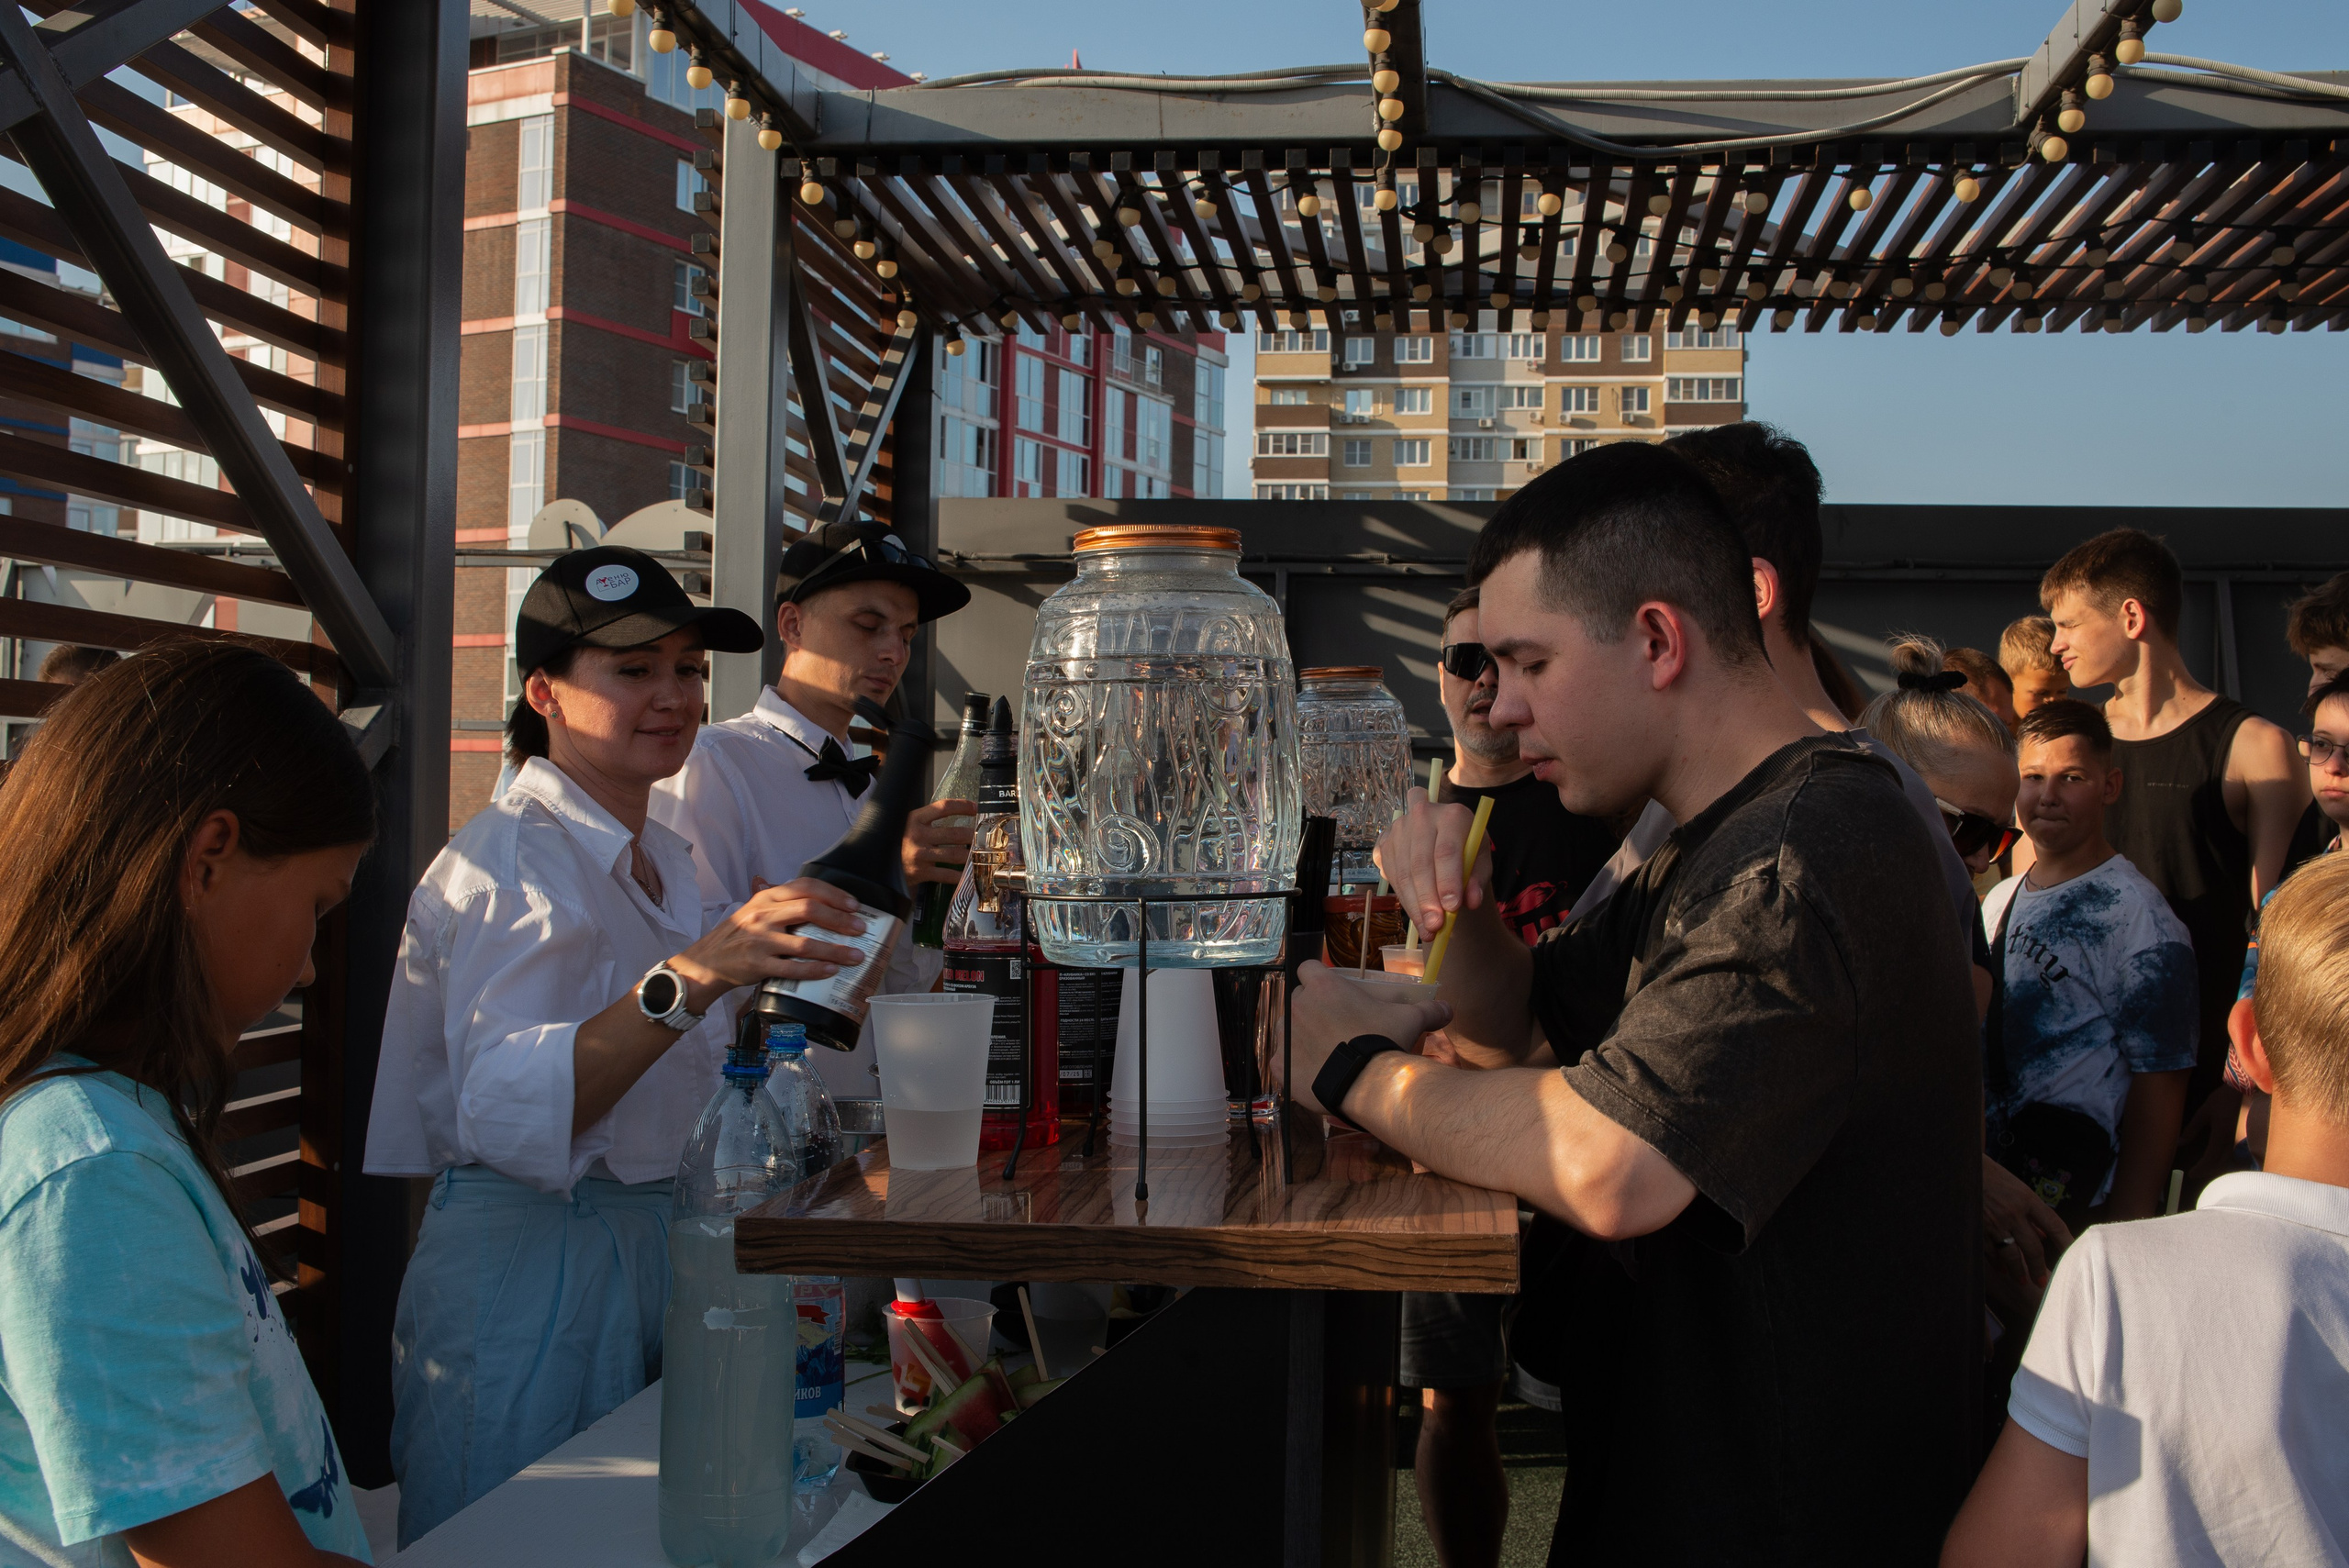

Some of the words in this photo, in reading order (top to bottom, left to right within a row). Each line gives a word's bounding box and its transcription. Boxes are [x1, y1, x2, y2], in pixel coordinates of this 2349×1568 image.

[609, 577, 631, 588] БАР
[2007, 922, 2072, 990] tiny
[955, 969, 985, 983] MELON
